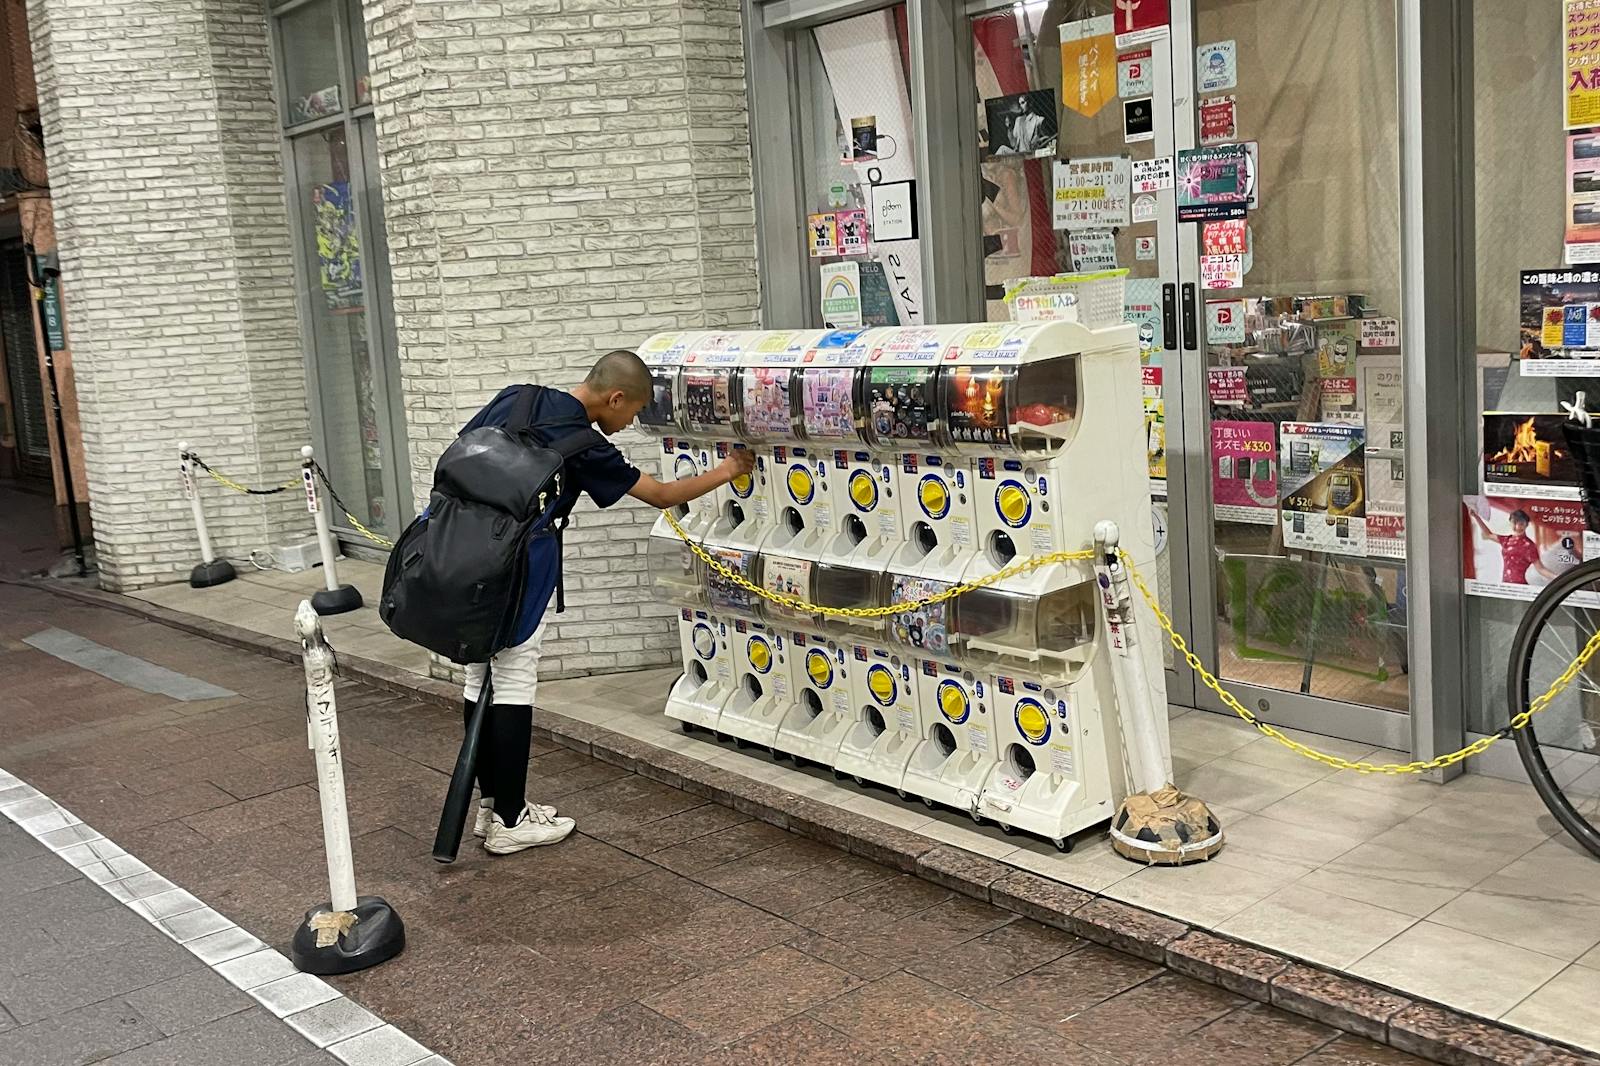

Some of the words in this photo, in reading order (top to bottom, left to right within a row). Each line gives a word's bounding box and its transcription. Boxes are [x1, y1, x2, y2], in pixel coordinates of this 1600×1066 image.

[1070, 161, 1114, 175] 営業時間
[1214, 325, 1237, 333] PayPay
[1323, 379, 1351, 389] たばこ
[1214, 427, 1251, 439] 丁度いい
[1244, 440, 1272, 452] ¥330
